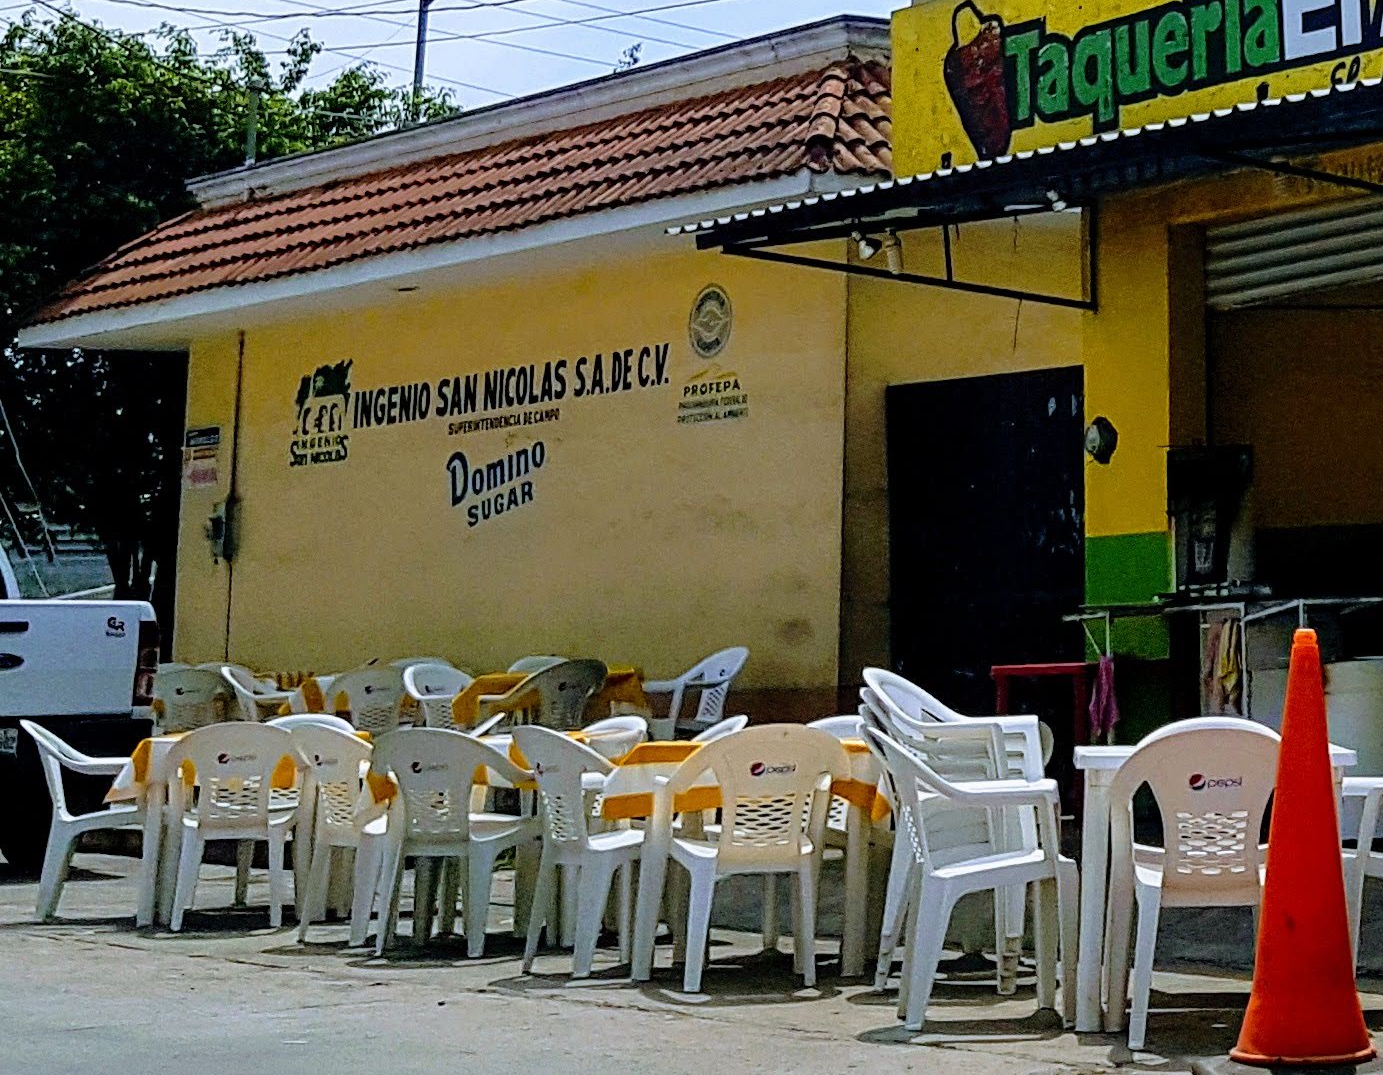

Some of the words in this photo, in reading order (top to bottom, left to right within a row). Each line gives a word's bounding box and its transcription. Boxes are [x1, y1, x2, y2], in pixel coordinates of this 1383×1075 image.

[353, 382, 431, 429] INGENIO
[436, 373, 478, 417] SAN
[483, 359, 567, 412] NICOLAS
[638, 343, 670, 387] C.V.
[683, 380, 741, 397] PROFEPA
[447, 441, 545, 507] Domino
[467, 480, 534, 528] SUGAR
[1207, 776, 1242, 789] pepsi
